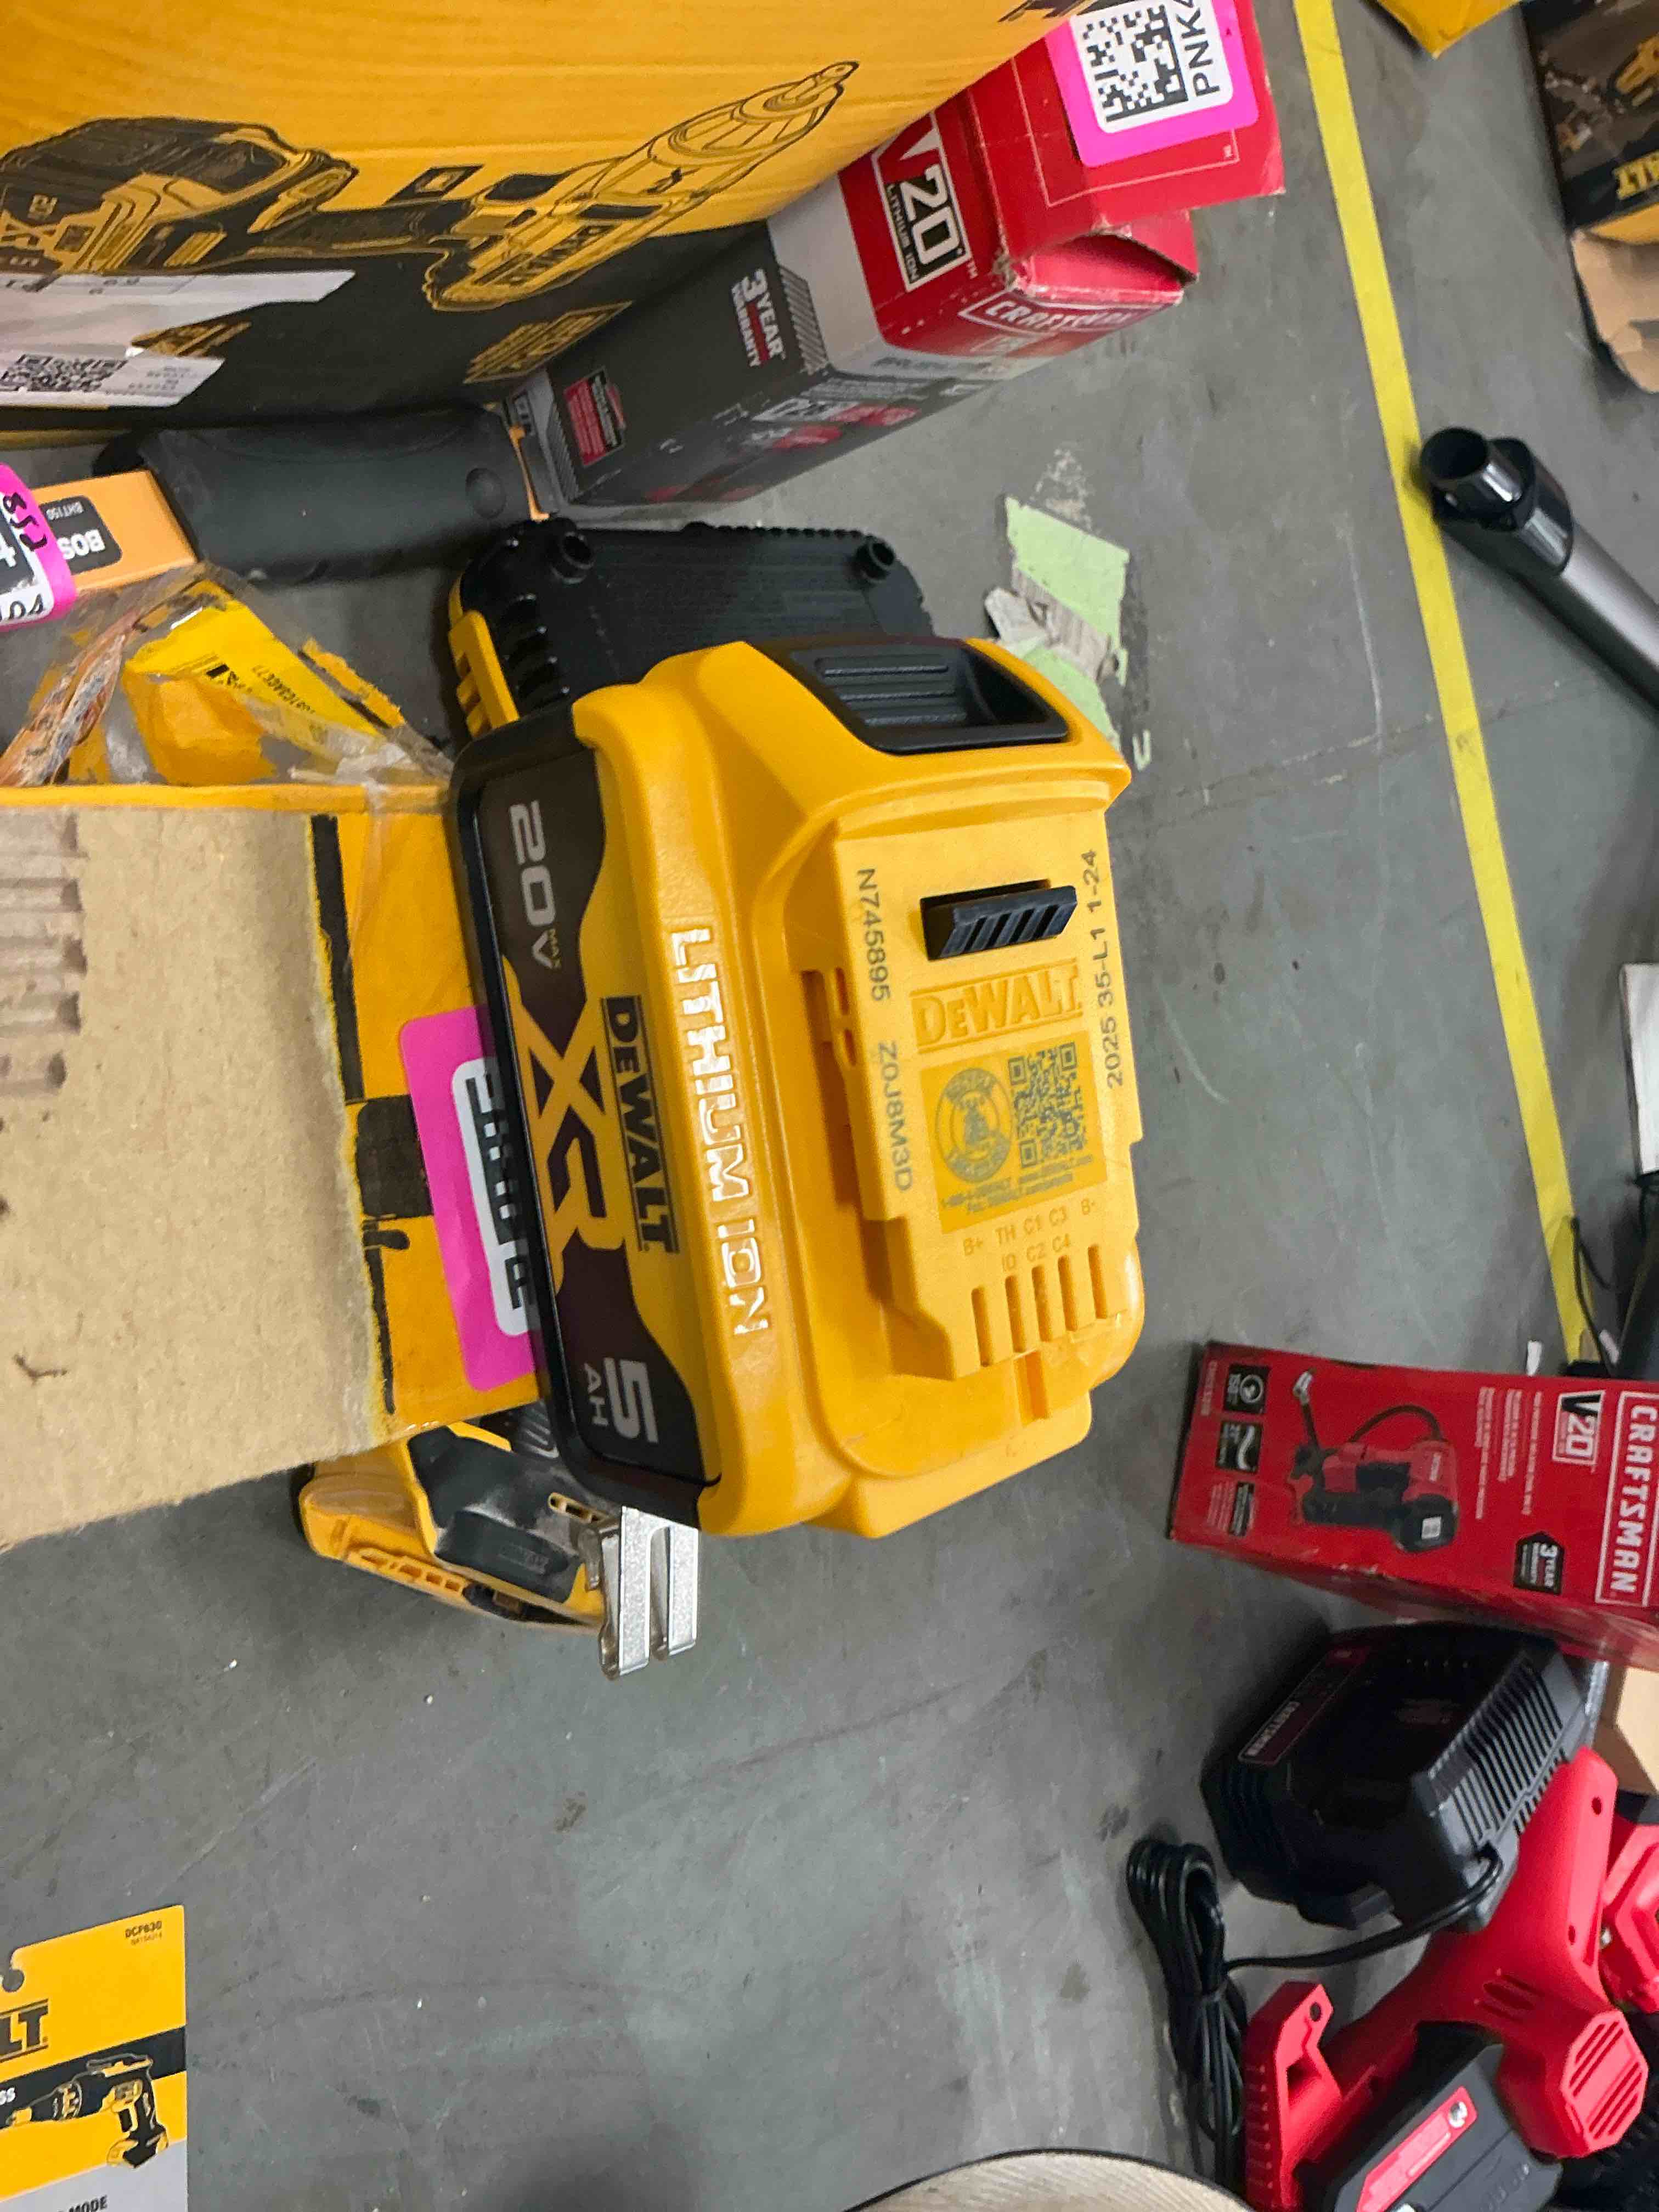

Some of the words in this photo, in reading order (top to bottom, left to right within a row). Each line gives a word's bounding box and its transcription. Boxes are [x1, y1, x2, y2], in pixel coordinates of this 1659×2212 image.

[741, 268, 769, 302] 3
[757, 291, 784, 359] YEAR
[1082, 848, 1104, 914] 1-24
[856, 867, 891, 1001] N745895
[1091, 927, 1115, 1008] 35-L1
[911, 967, 1080, 1049] DEWALT
[1097, 1017, 1124, 1090] 2025
[504, 957, 627, 1296] XR
[604, 996, 679, 1253] DEWALT
[671, 928, 751, 1203] LITHIUM
[717, 1218, 770, 1335] ION
[583, 1362, 609, 1426] AH
[603, 1356, 658, 1443] 5
[1561, 1393, 1602, 1458] V20
[1610, 1404, 1659, 1594] CRAFTSMAN
[1539, 1543, 1558, 1559] 3
